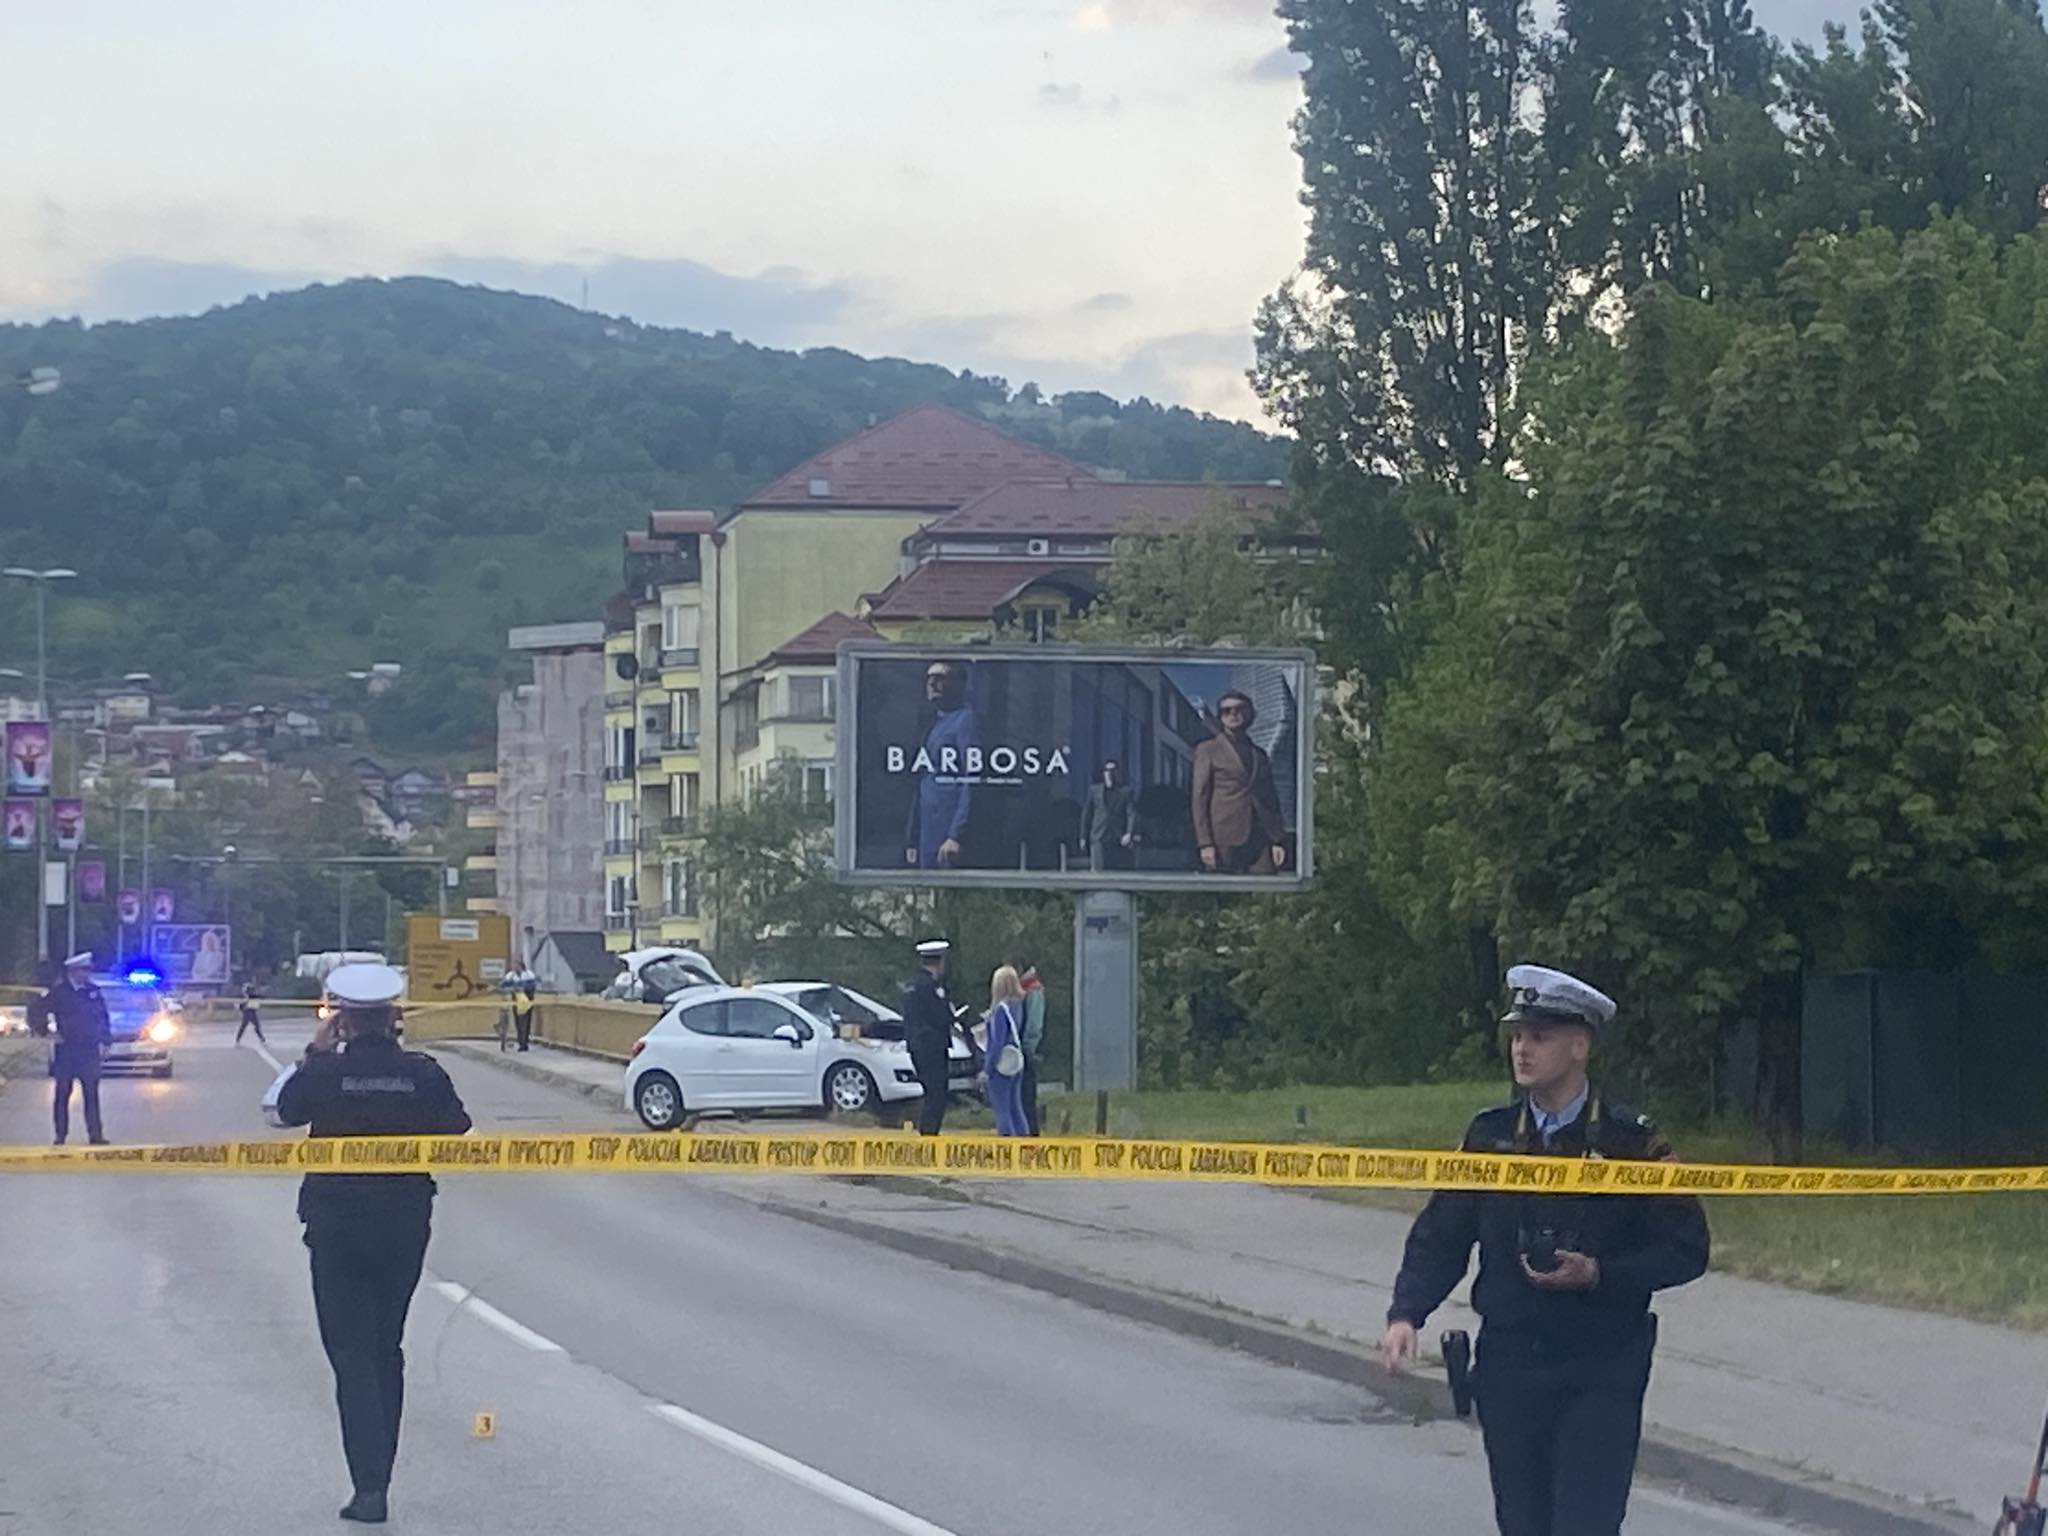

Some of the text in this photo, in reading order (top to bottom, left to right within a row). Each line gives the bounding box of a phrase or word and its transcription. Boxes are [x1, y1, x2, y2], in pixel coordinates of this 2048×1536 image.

[887, 745, 1069, 775] BARBOSA
[587, 1137, 621, 1161] STOP
[1094, 1143, 1125, 1168] STOP
[479, 1416, 491, 1433] 3
